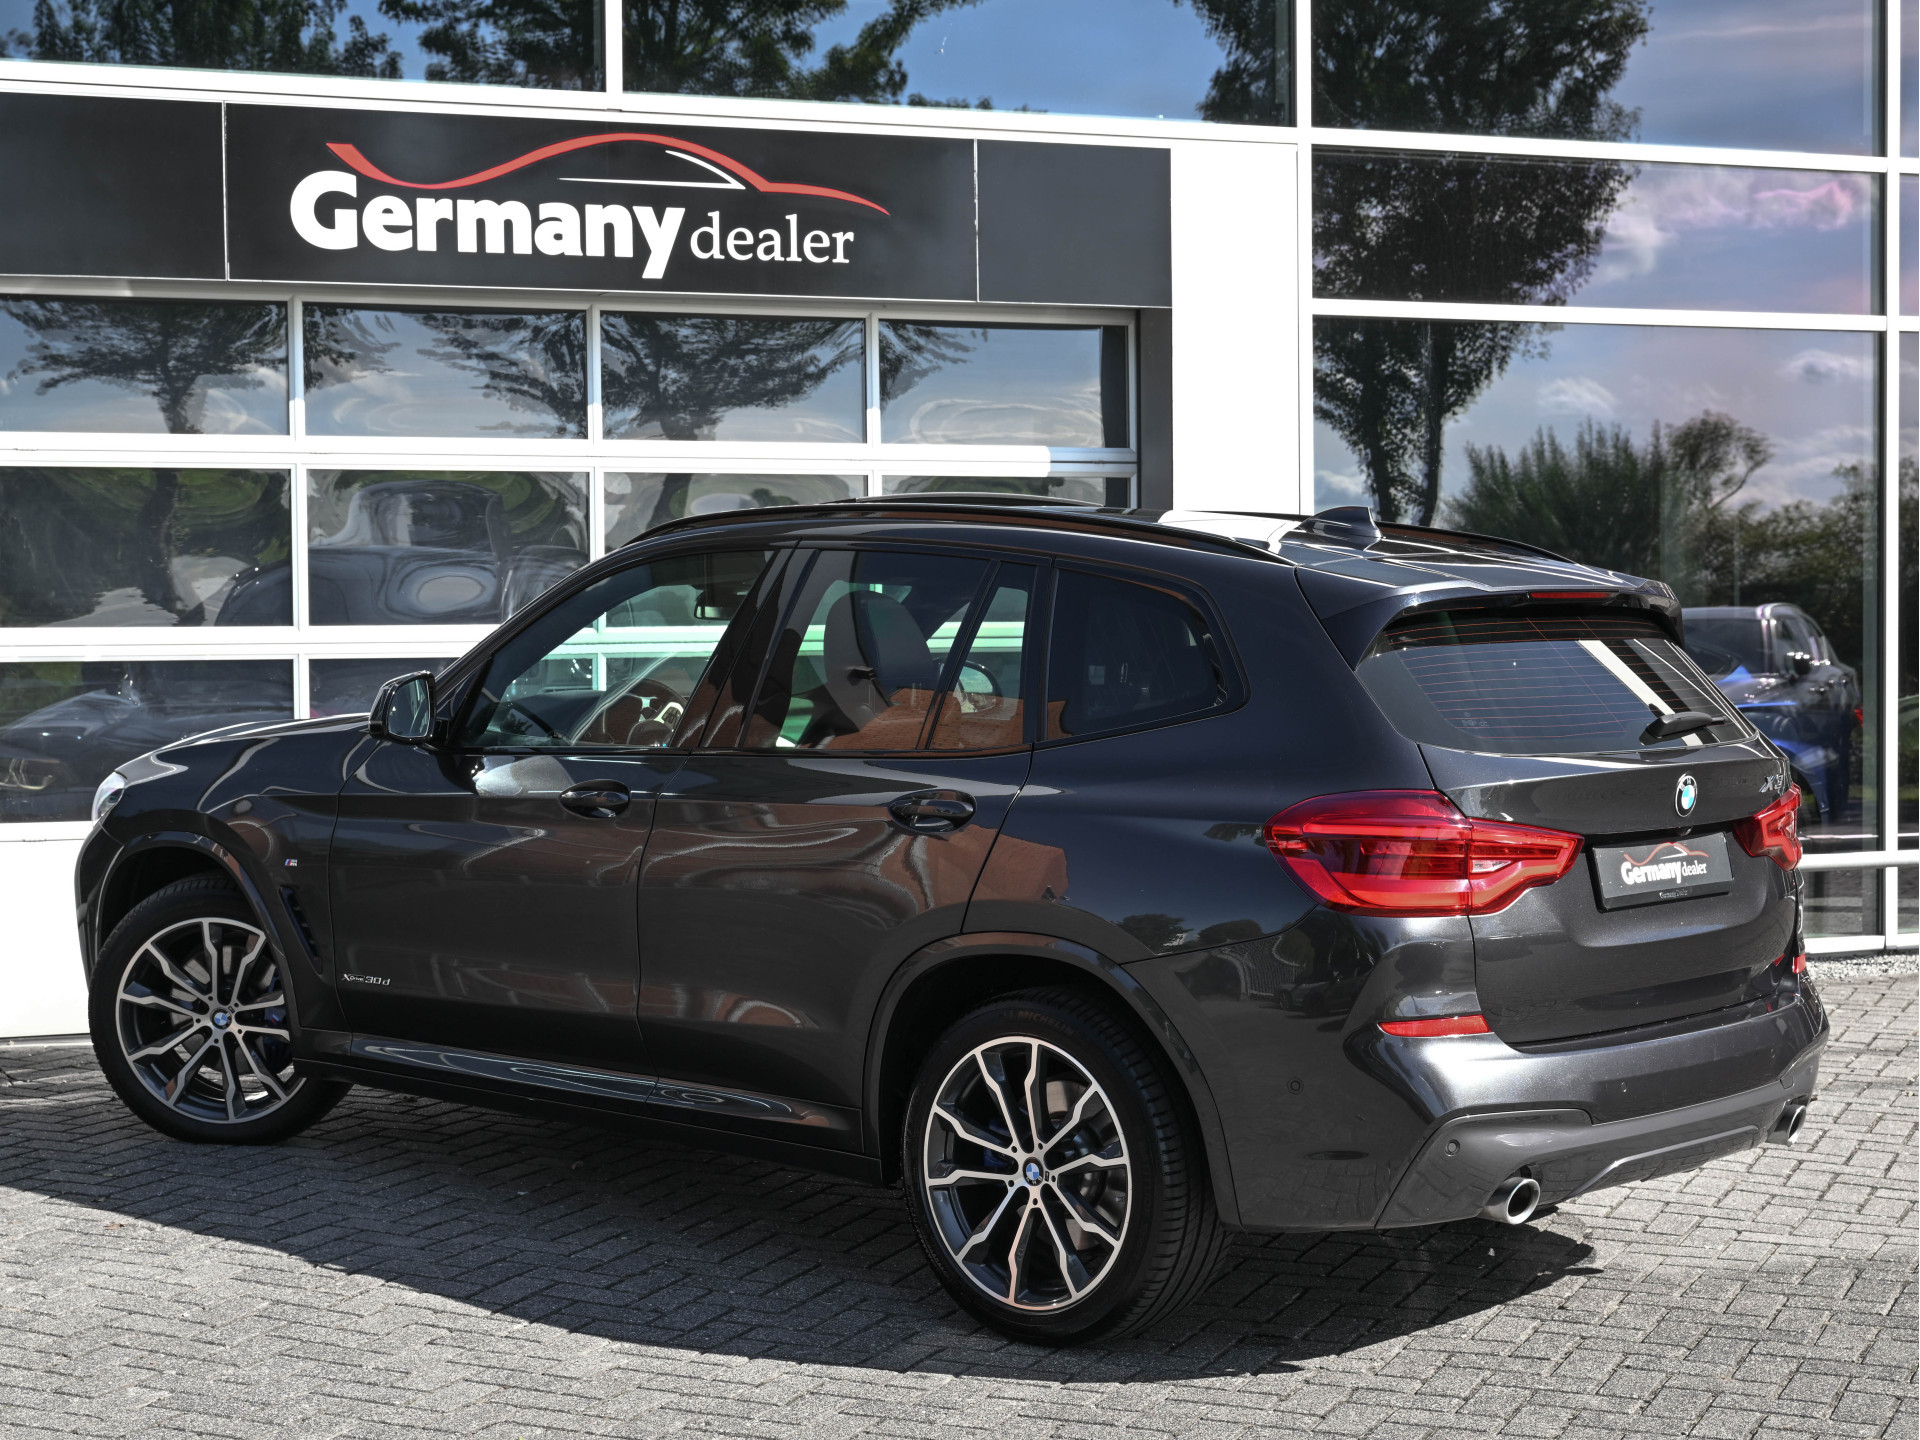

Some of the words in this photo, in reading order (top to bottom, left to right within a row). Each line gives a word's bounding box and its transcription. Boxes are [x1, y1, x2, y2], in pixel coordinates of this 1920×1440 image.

[290, 170, 685, 279] Germany
[690, 211, 854, 264] dealer
[1759, 774, 1784, 793] X3
[1621, 861, 1681, 885] Germany
[1682, 860, 1707, 876] dealer
